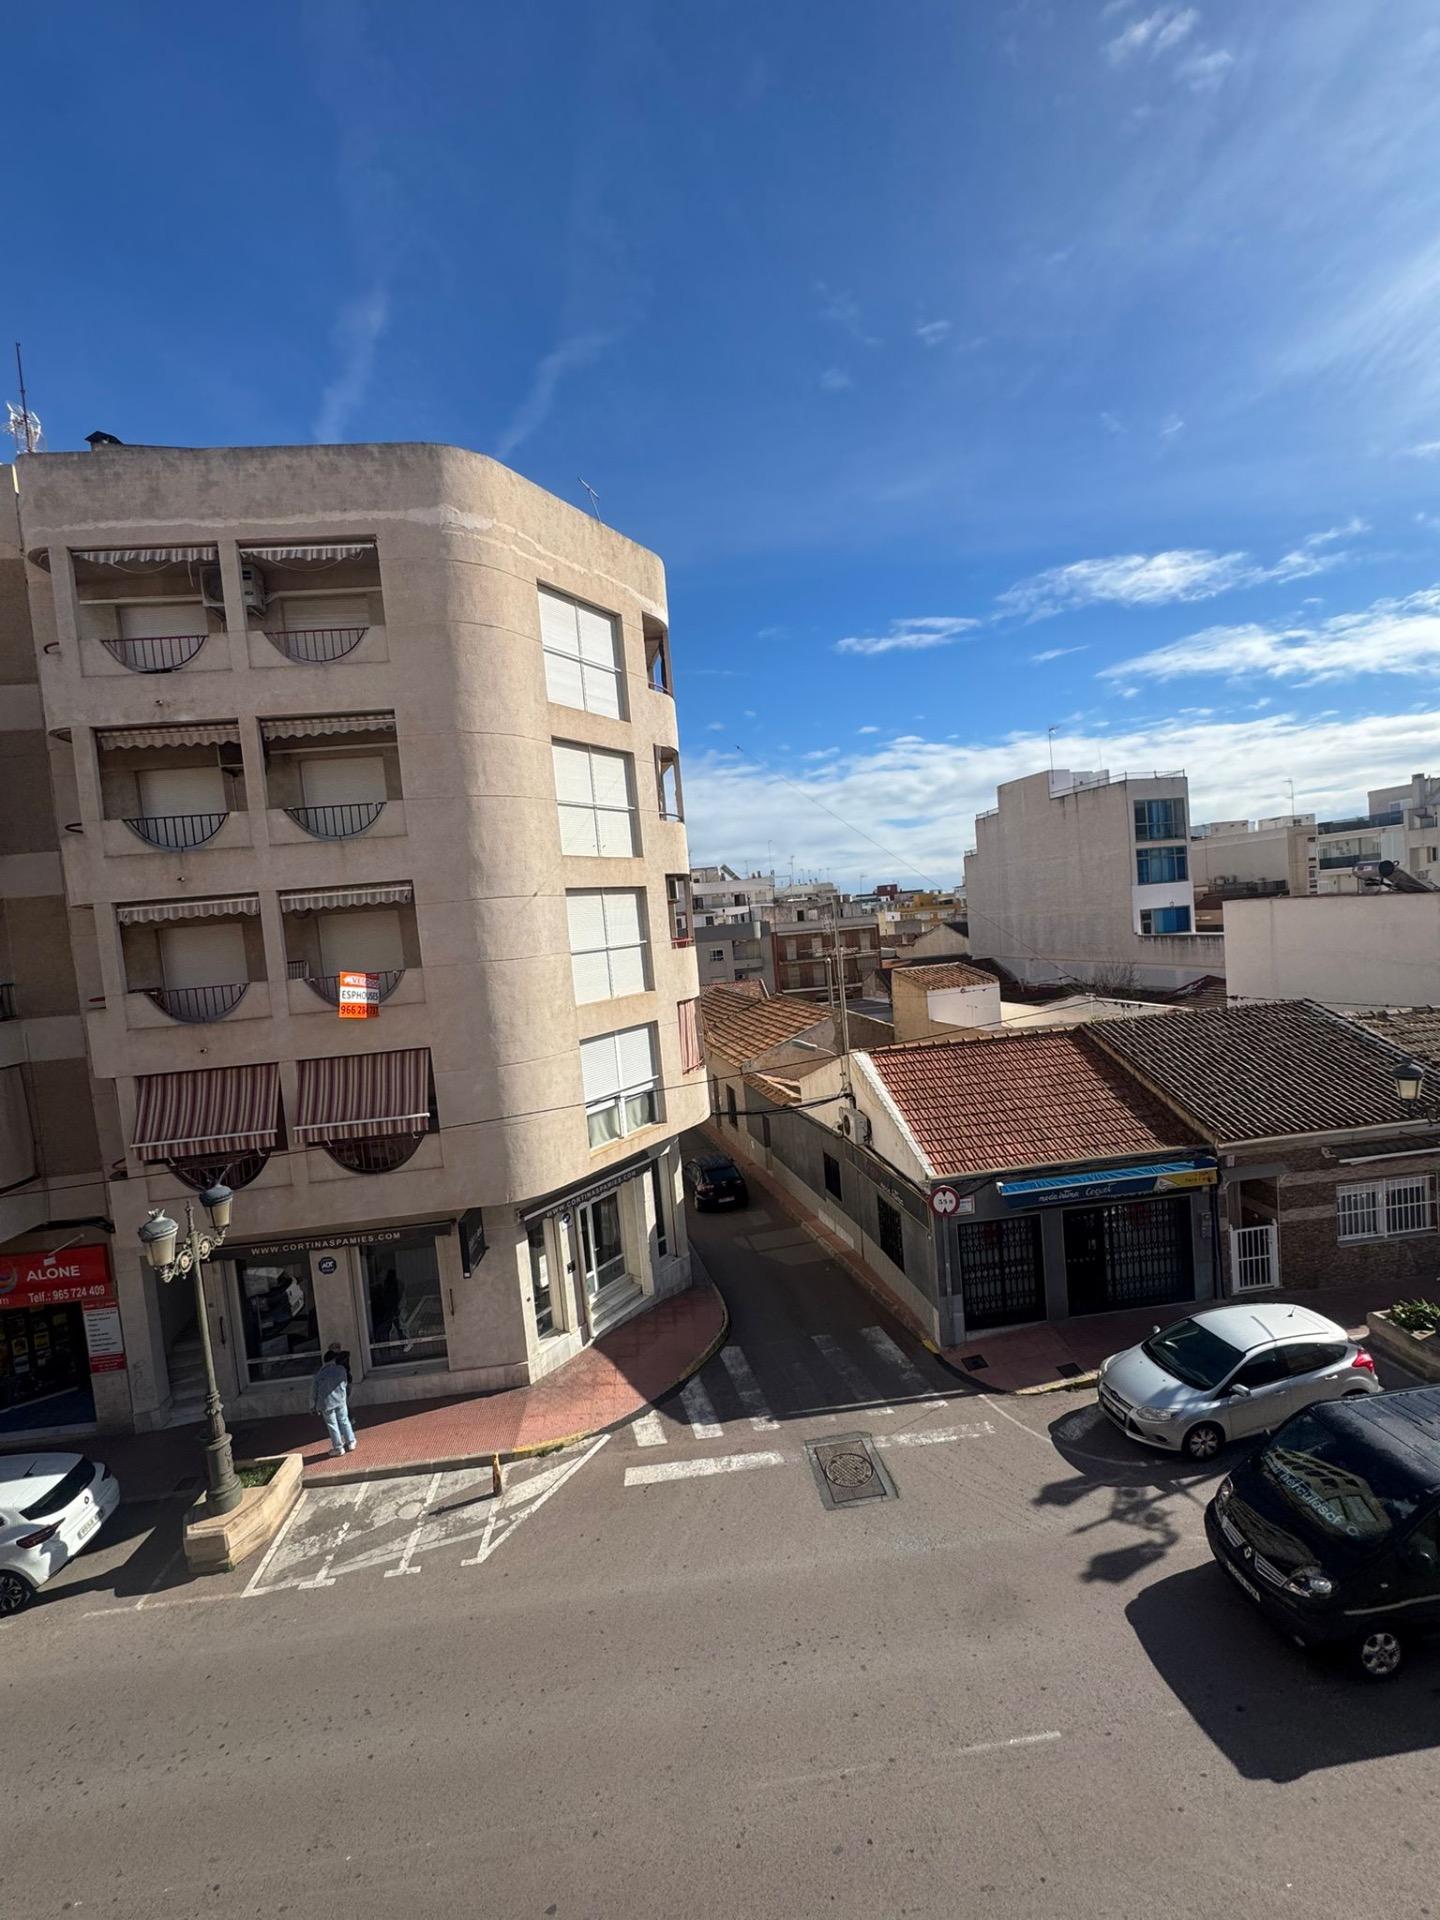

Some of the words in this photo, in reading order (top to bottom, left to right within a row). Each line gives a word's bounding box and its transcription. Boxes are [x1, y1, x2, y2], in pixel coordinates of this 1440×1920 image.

[251, 1232, 401, 1255] WWW.CORTINASPAMIES.COM
[26, 1265, 81, 1282] ALONE
[52, 1288, 70, 1300] 965
[70, 1286, 87, 1298] 724
[89, 1284, 105, 1296] 409
